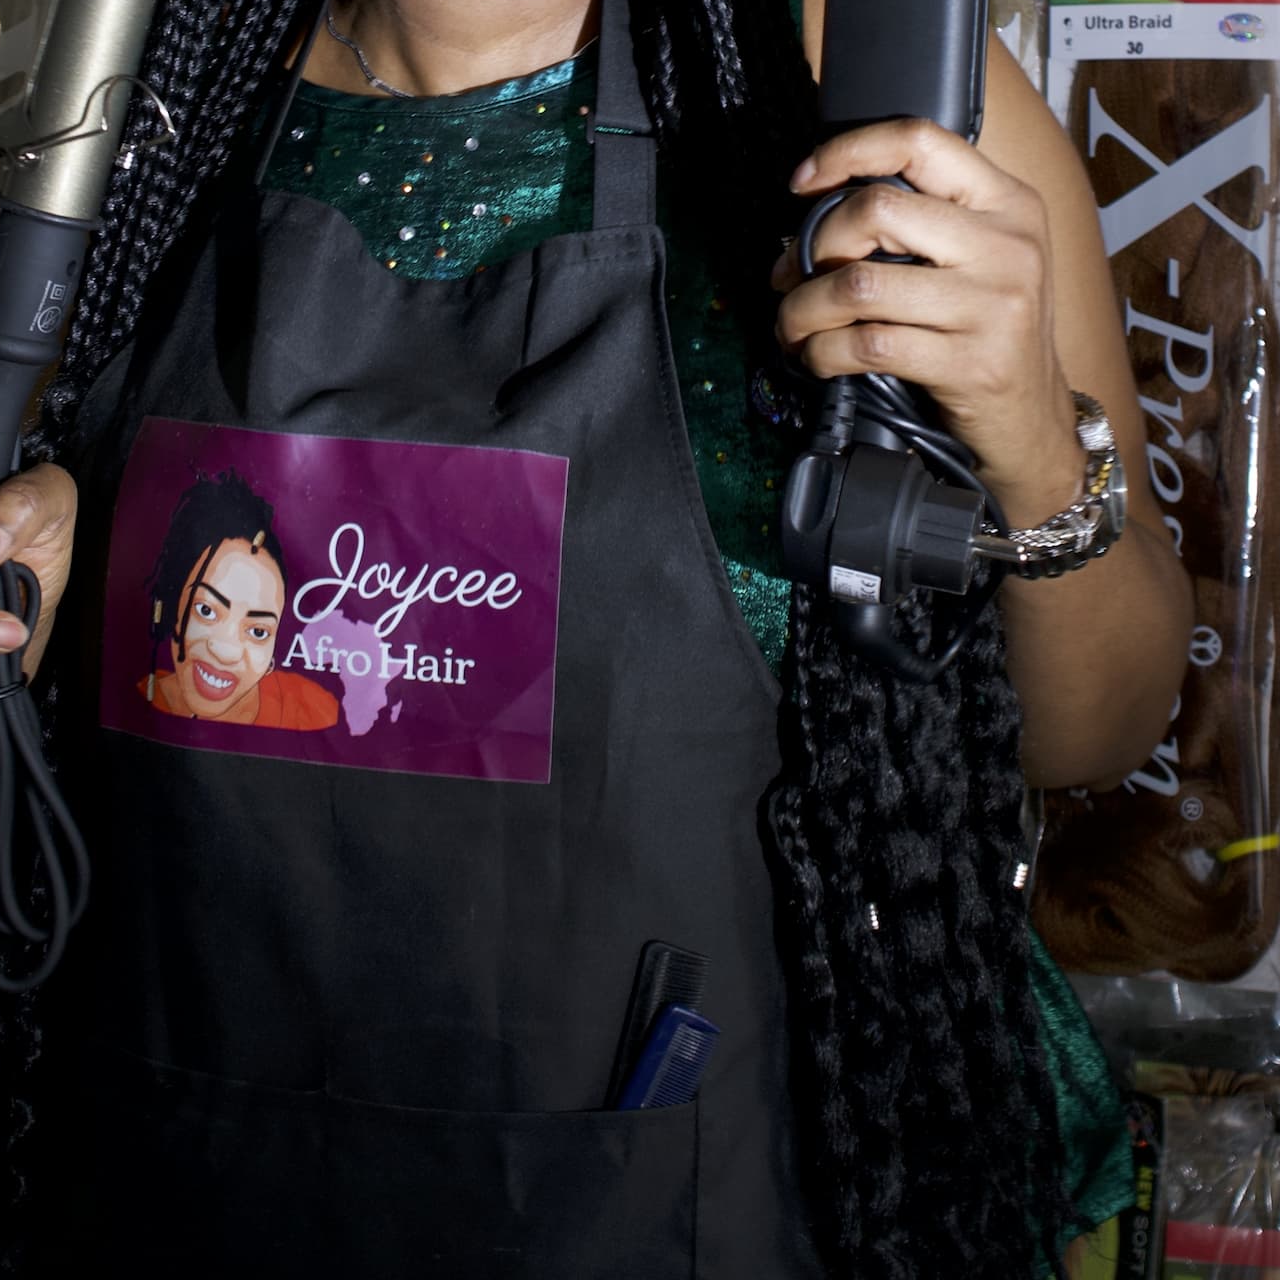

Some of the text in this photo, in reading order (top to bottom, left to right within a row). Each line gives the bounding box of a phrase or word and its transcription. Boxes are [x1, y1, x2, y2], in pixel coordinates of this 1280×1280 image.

[1085, 15, 1172, 29] Ultra Braid
[292, 523, 522, 637] Joycee
[282, 633, 475, 685] Afro Hair
